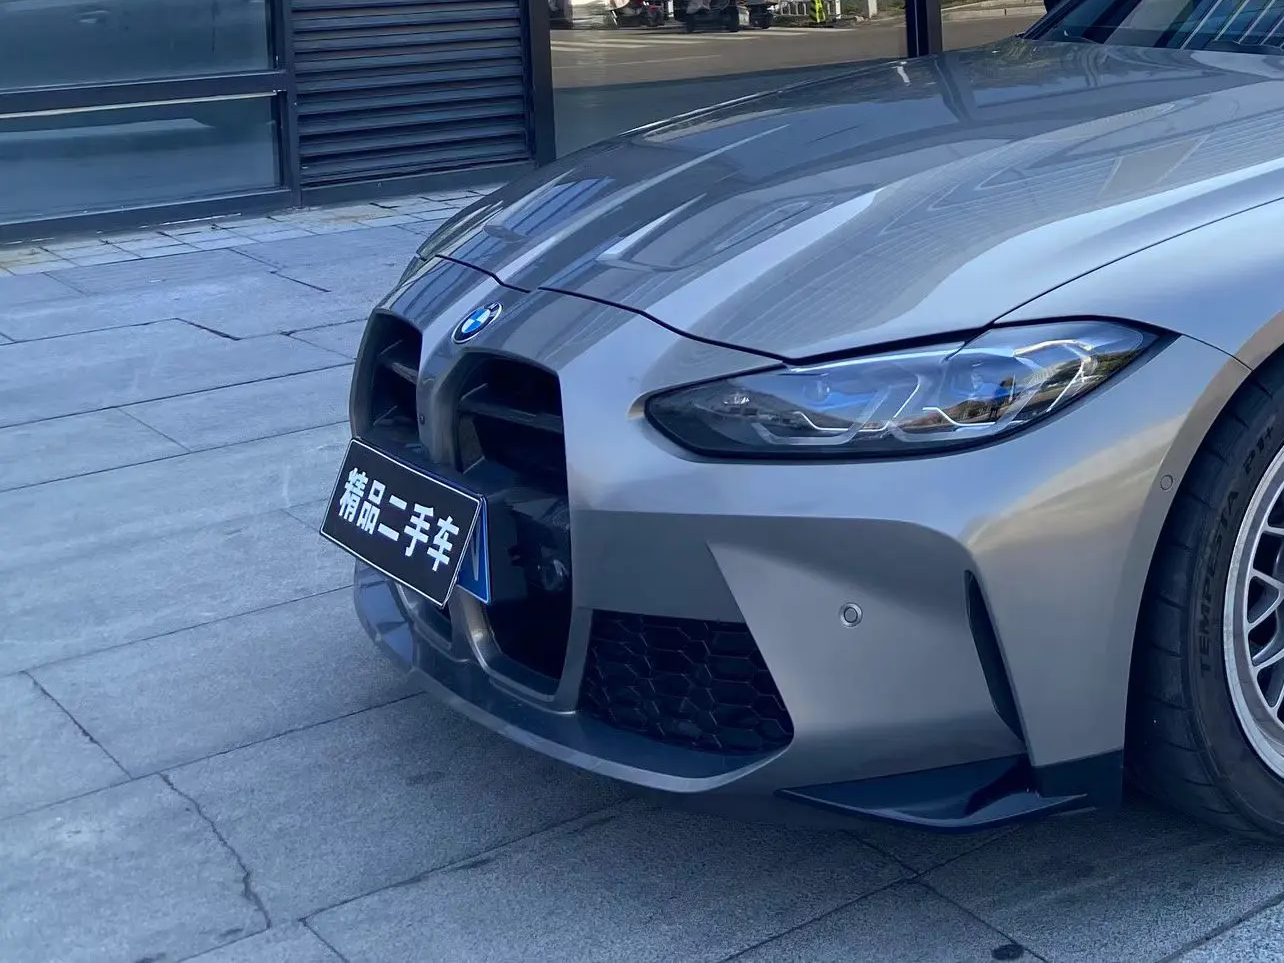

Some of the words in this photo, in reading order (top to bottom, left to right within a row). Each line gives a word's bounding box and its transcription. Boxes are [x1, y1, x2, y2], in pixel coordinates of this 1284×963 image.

[338, 467, 460, 572] 精品二手车
[1199, 489, 1240, 679] TEMPESTA
